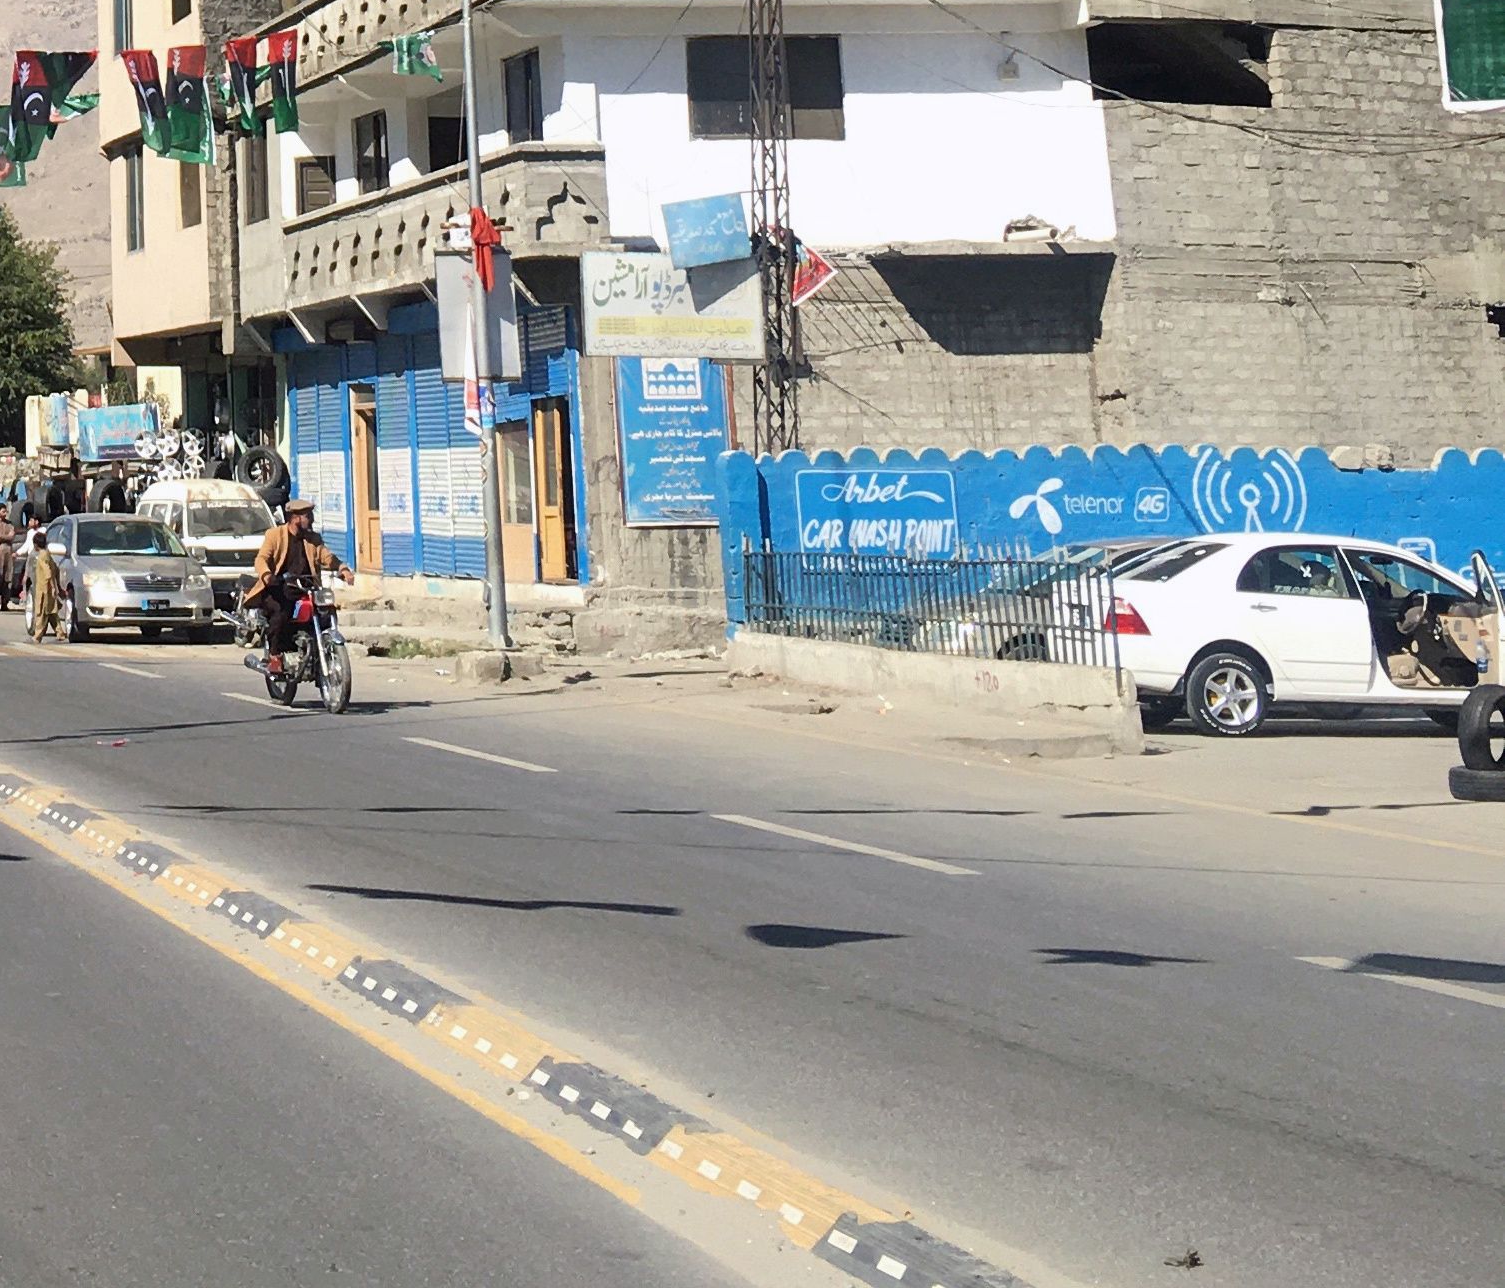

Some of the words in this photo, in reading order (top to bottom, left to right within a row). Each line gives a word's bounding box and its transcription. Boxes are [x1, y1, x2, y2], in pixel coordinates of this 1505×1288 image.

[821, 473, 945, 503] Arbet
[1063, 494, 1124, 514] telenor
[1137, 494, 1165, 514] 4G
[803, 518, 843, 549] CAR
[848, 518, 902, 551] WASH
[903, 518, 956, 553] POINT
